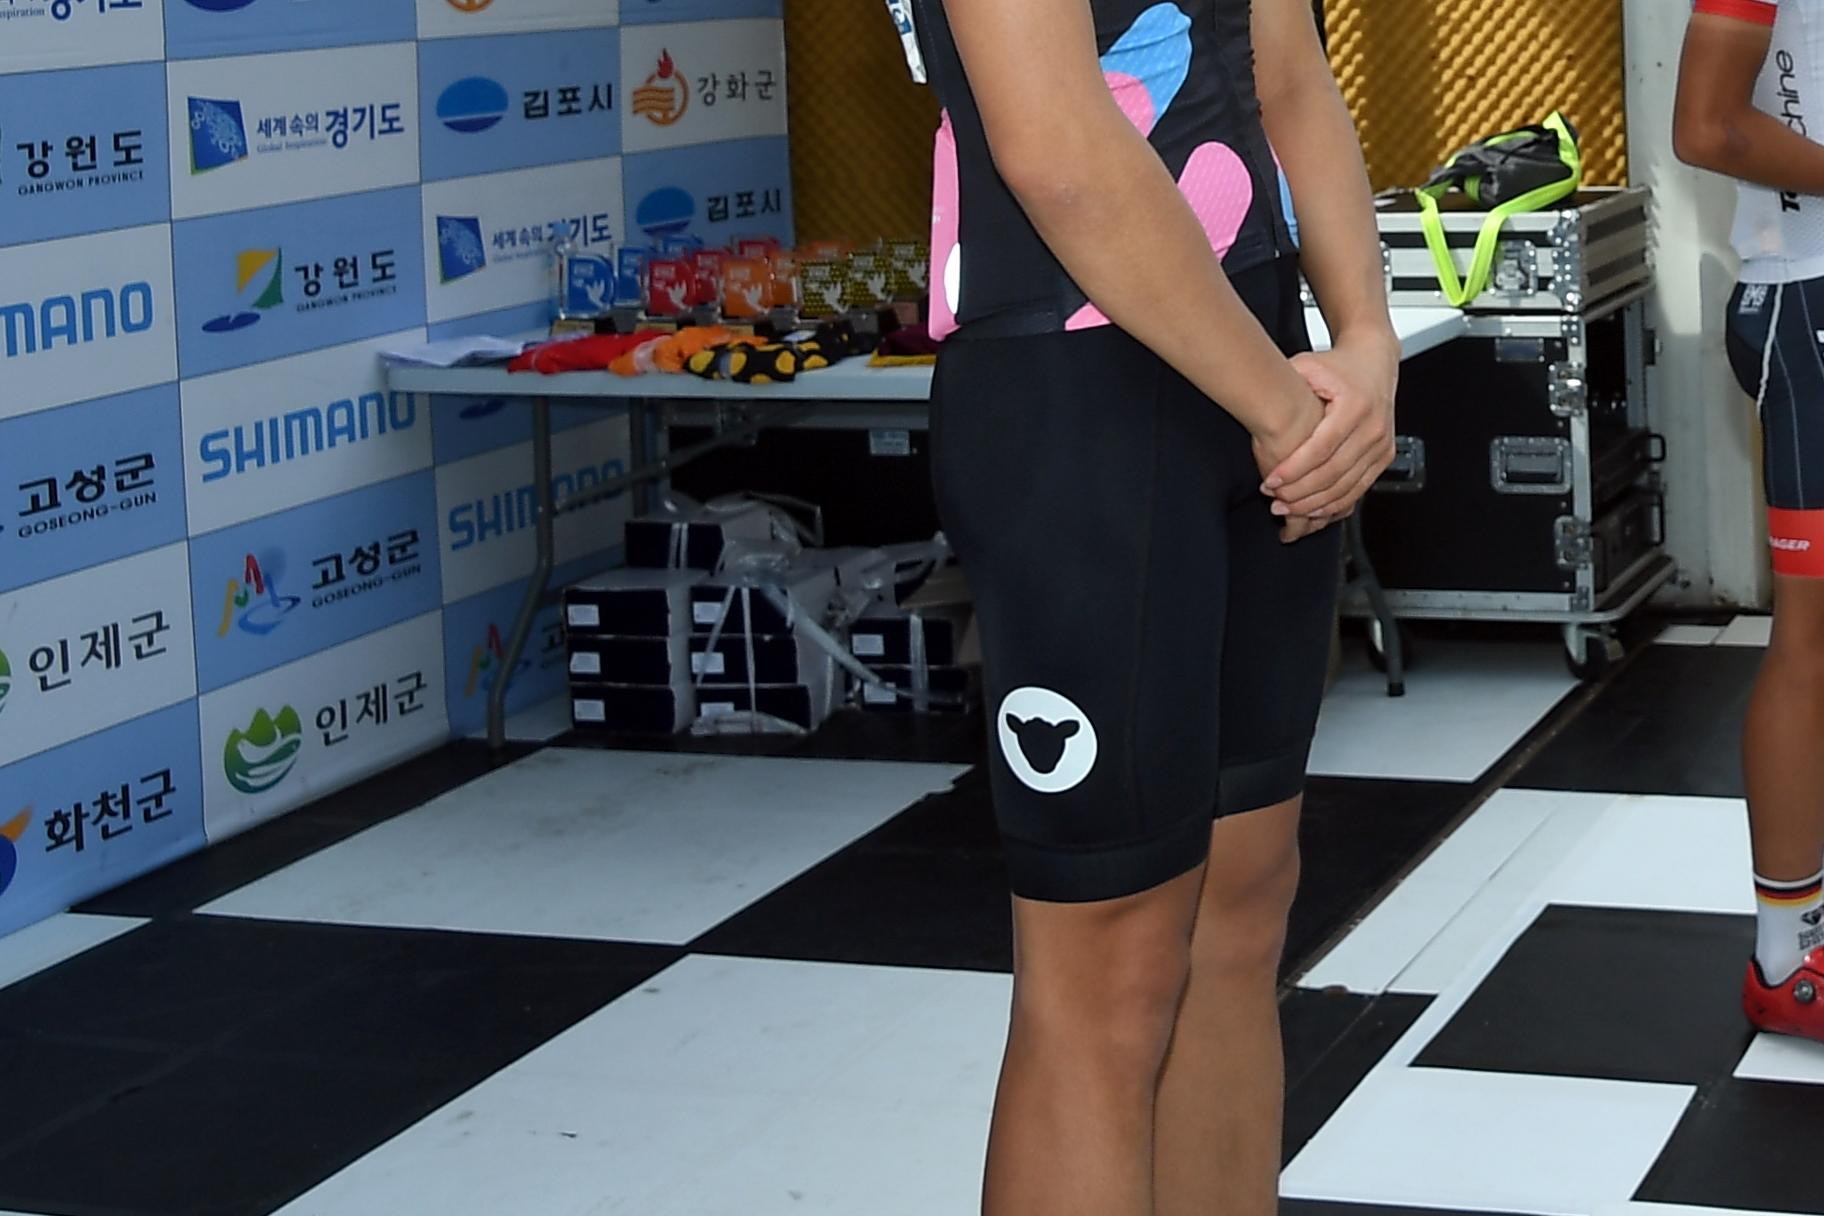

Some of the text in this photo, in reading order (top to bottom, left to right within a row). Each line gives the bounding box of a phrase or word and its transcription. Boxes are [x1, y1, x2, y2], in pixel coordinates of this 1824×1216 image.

[523, 83, 613, 120] 김포시
[698, 70, 777, 105] 강화군
[256, 103, 404, 149] 세계 속의 경기도
[16, 130, 144, 179] 강원도
[707, 188, 782, 222] 김포시
[548, 213, 612, 248] 기도
[295, 249, 396, 297] 강원도
[18, 453, 155, 517] 고성군
[18, 492, 157, 539] GOSEONG-GUN
[312, 529, 420, 590] 고성군
[29, 610, 170, 692] 인제군
[315, 671, 427, 747] 인제군
[44, 768, 175, 853] 화천군
